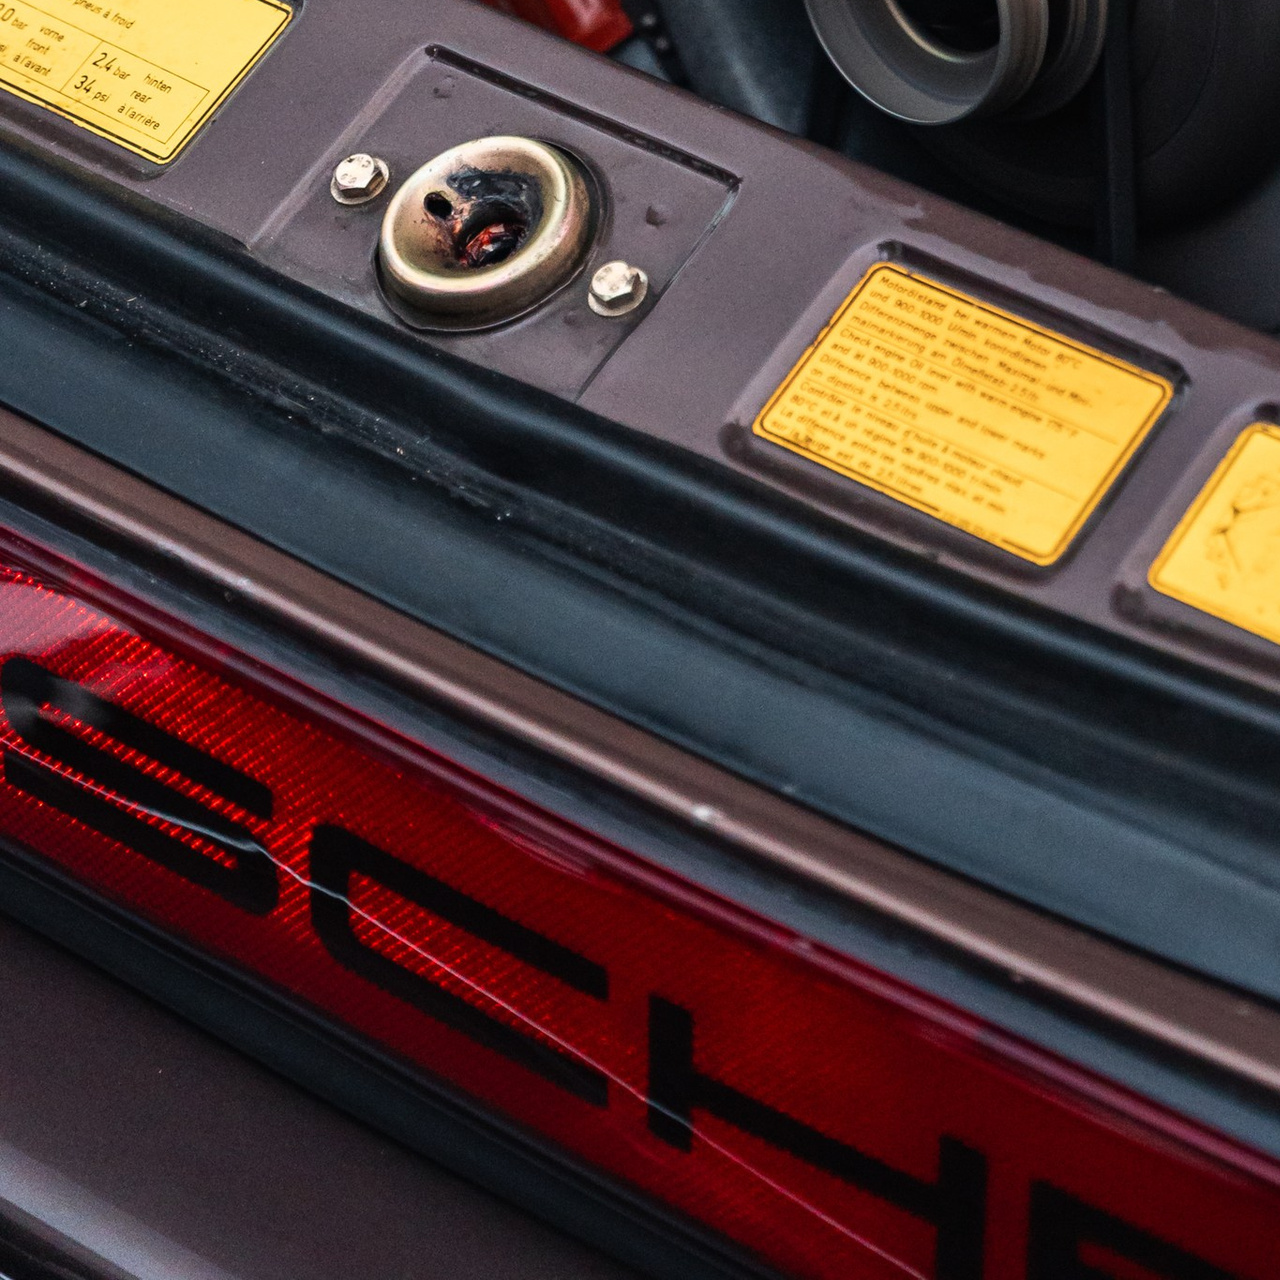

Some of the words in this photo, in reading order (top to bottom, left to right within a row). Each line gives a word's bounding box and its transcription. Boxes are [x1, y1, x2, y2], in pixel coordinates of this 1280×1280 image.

[111, 13, 135, 29] froid
[39, 27, 64, 42] vorne
[26, 38, 50, 54] front
[112, 66, 130, 79] bar
[144, 73, 171, 93] hinten
[74, 75, 96, 93] 34
[91, 91, 109, 102] psi
[130, 90, 151, 103] rear
[869, 290, 890, 303] und
[858, 301, 937, 340] Differenzmenge
[830, 342, 851, 355] and
[839, 328, 872, 346] Check
[873, 345, 906, 361] engine
[929, 349, 947, 359] am
[819, 354, 872, 381] Difference
[877, 380, 920, 401] between
[826, 376, 865, 395] dipstick
